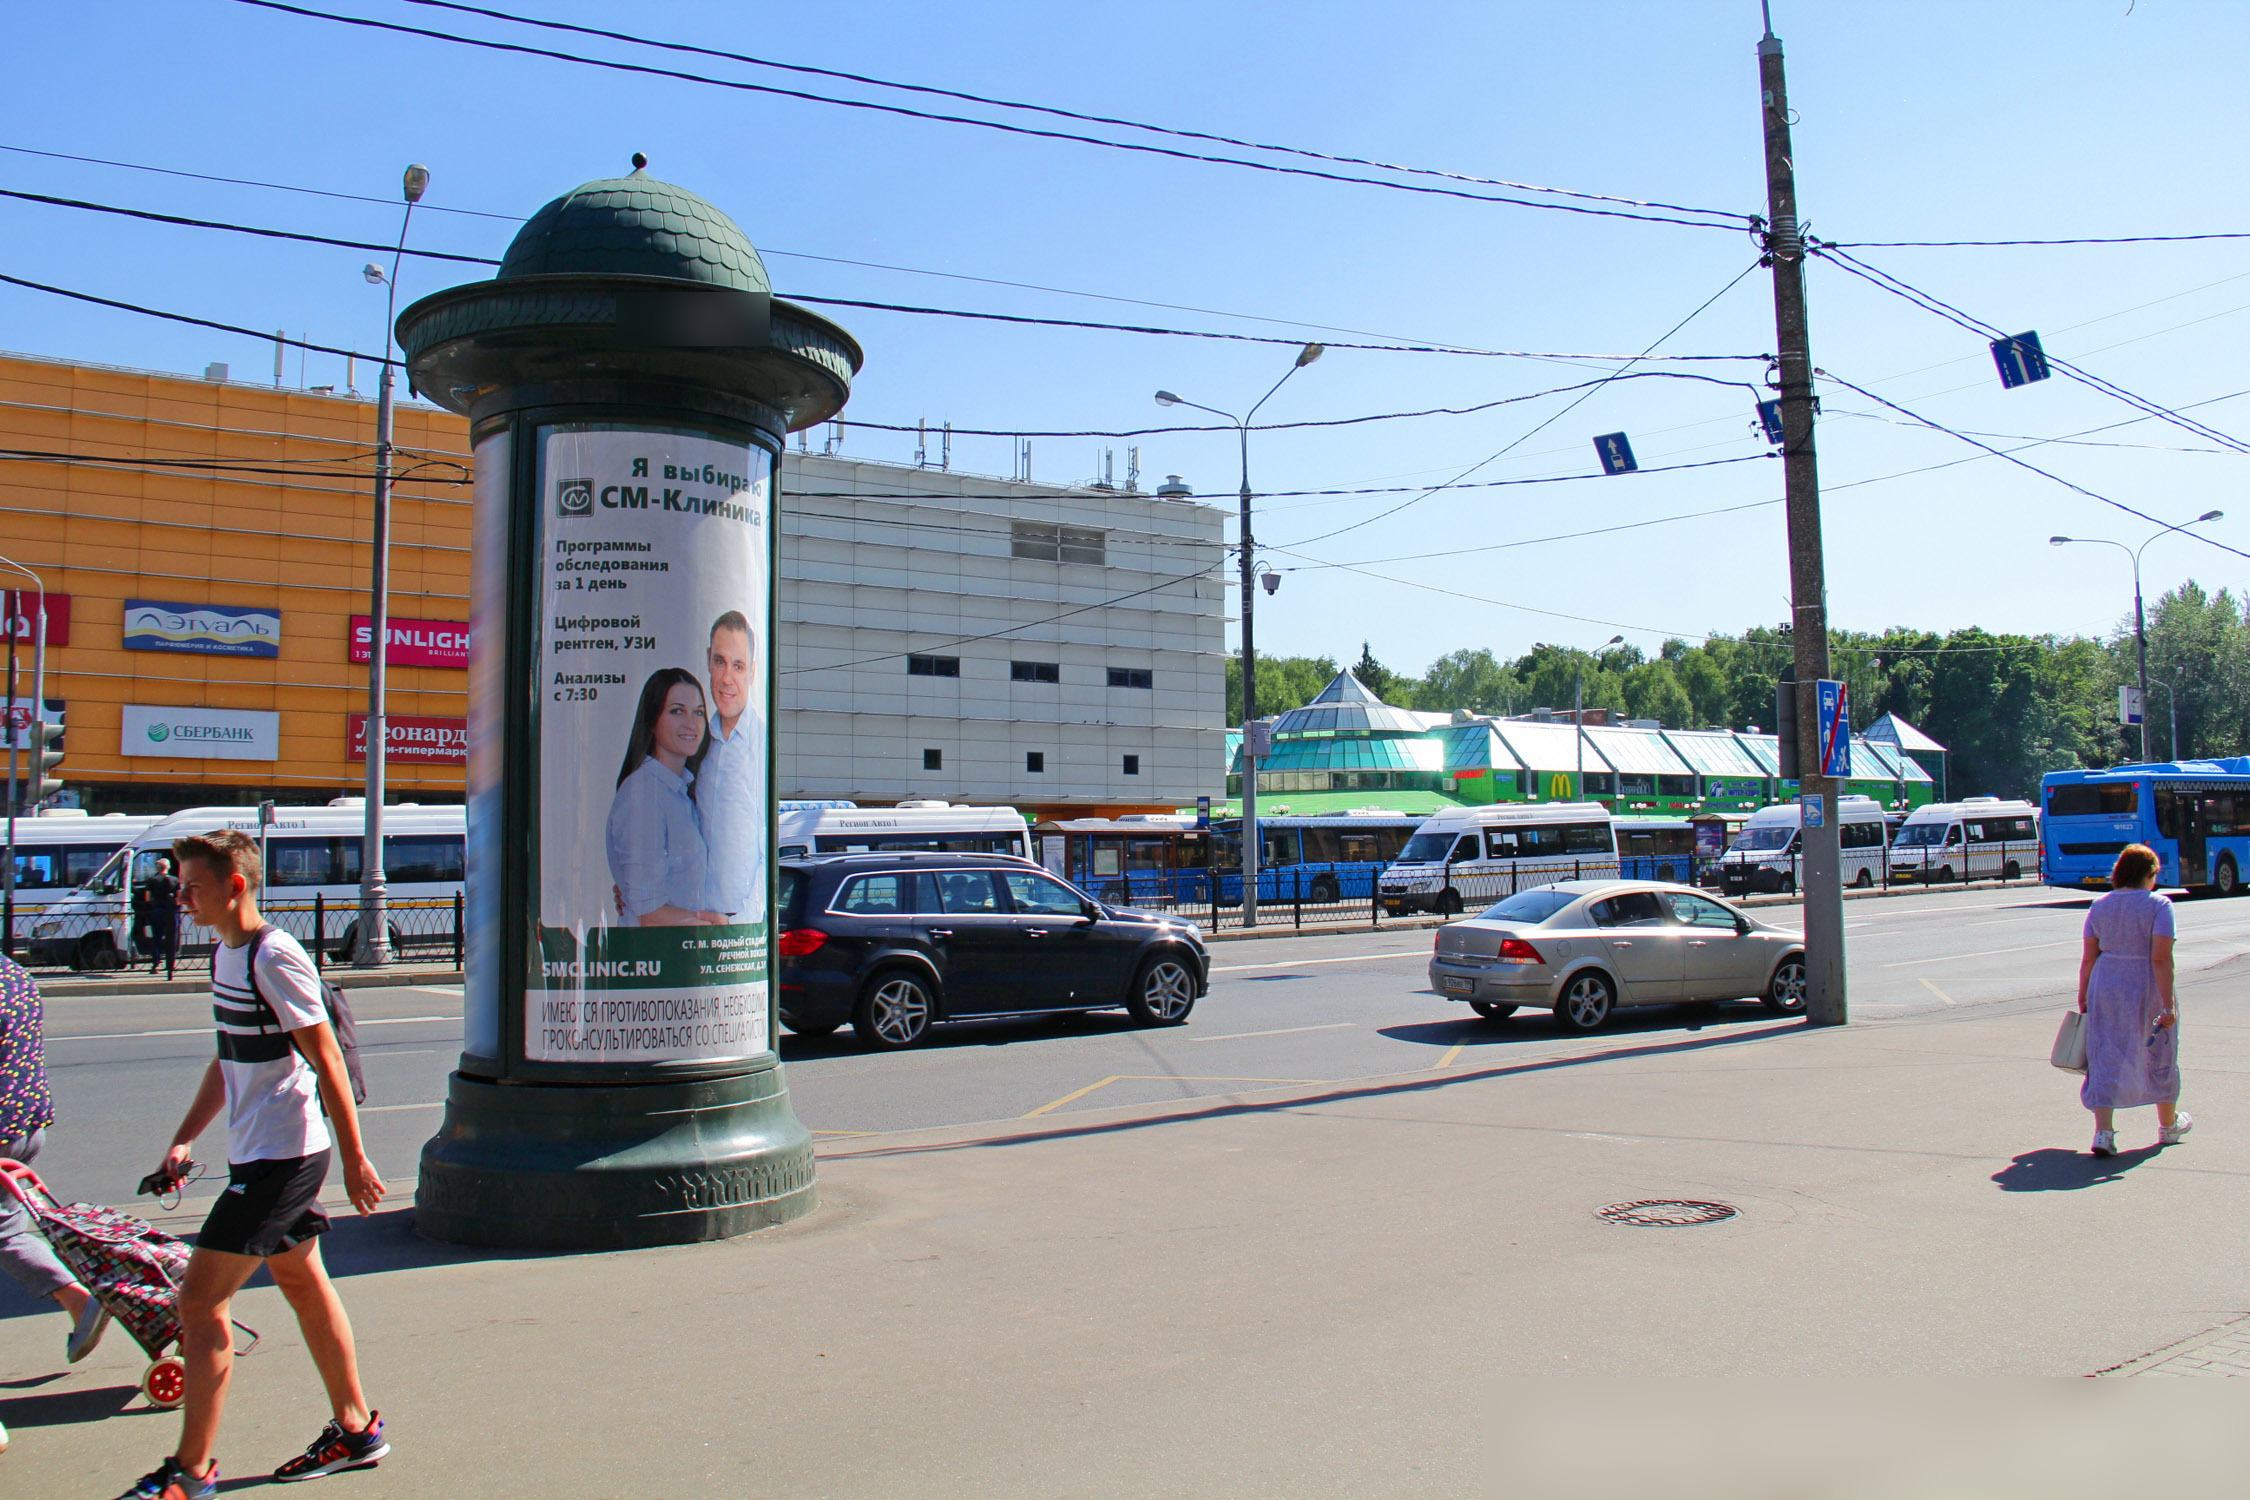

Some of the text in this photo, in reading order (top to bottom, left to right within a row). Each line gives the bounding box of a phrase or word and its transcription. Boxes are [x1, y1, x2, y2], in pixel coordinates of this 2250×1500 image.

[632, 457, 649, 477] Я
[600, 485, 762, 527] СМ-Клиника
[556, 540, 652, 554] Программы
[555, 558, 669, 572] обследования
[555, 577, 627, 591] за 1 день
[554, 614, 641, 631] Цифровой
[554, 637, 656, 654] рентген, УЗИ
[554, 672, 626, 685] Анализы
[554, 688, 597, 702] с 7:30
[173, 725, 254, 740] СБЕРБАНК
[840, 819, 869, 828] Регион
[872, 819, 891, 827] Авто
[711, 936, 745, 949] ВОДНЫЙ
[541, 960, 662, 977] SMCLINIC.RU
[695, 1025, 710, 1046] СО
